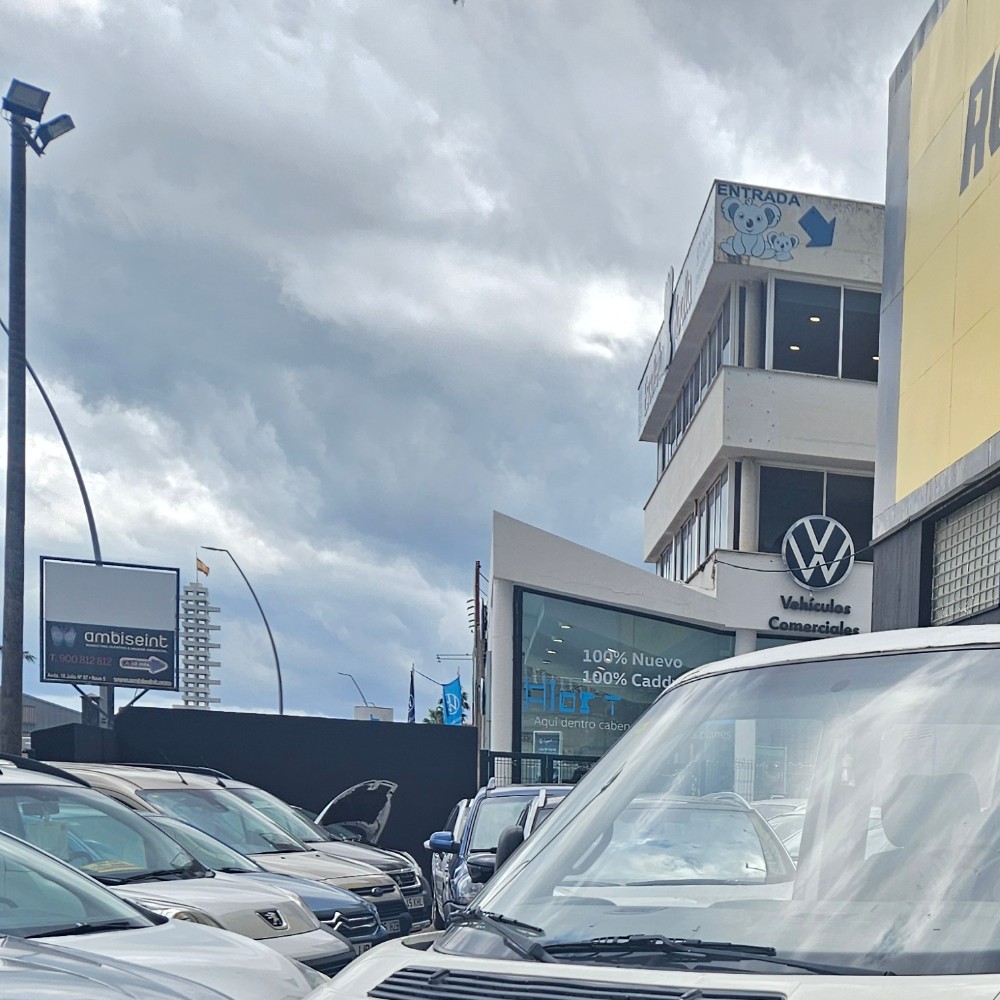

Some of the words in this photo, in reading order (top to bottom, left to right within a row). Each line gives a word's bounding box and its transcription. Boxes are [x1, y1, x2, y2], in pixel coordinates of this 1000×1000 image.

[717, 183, 801, 207] ENTRADA
[780, 592, 852, 615] Vehículos
[768, 616, 861, 635] Comerciales
[84, 631, 168, 648] ambiseint
[59, 654, 78, 663] 900
[80, 655, 96, 665] 812
[97, 656, 113, 666] 812
[583, 649, 627, 665] 100%
[632, 652, 683, 668] Nuevo
[583, 670, 627, 687] 100%
[561, 717, 596, 730] dentro
[599, 720, 631, 732] caben
